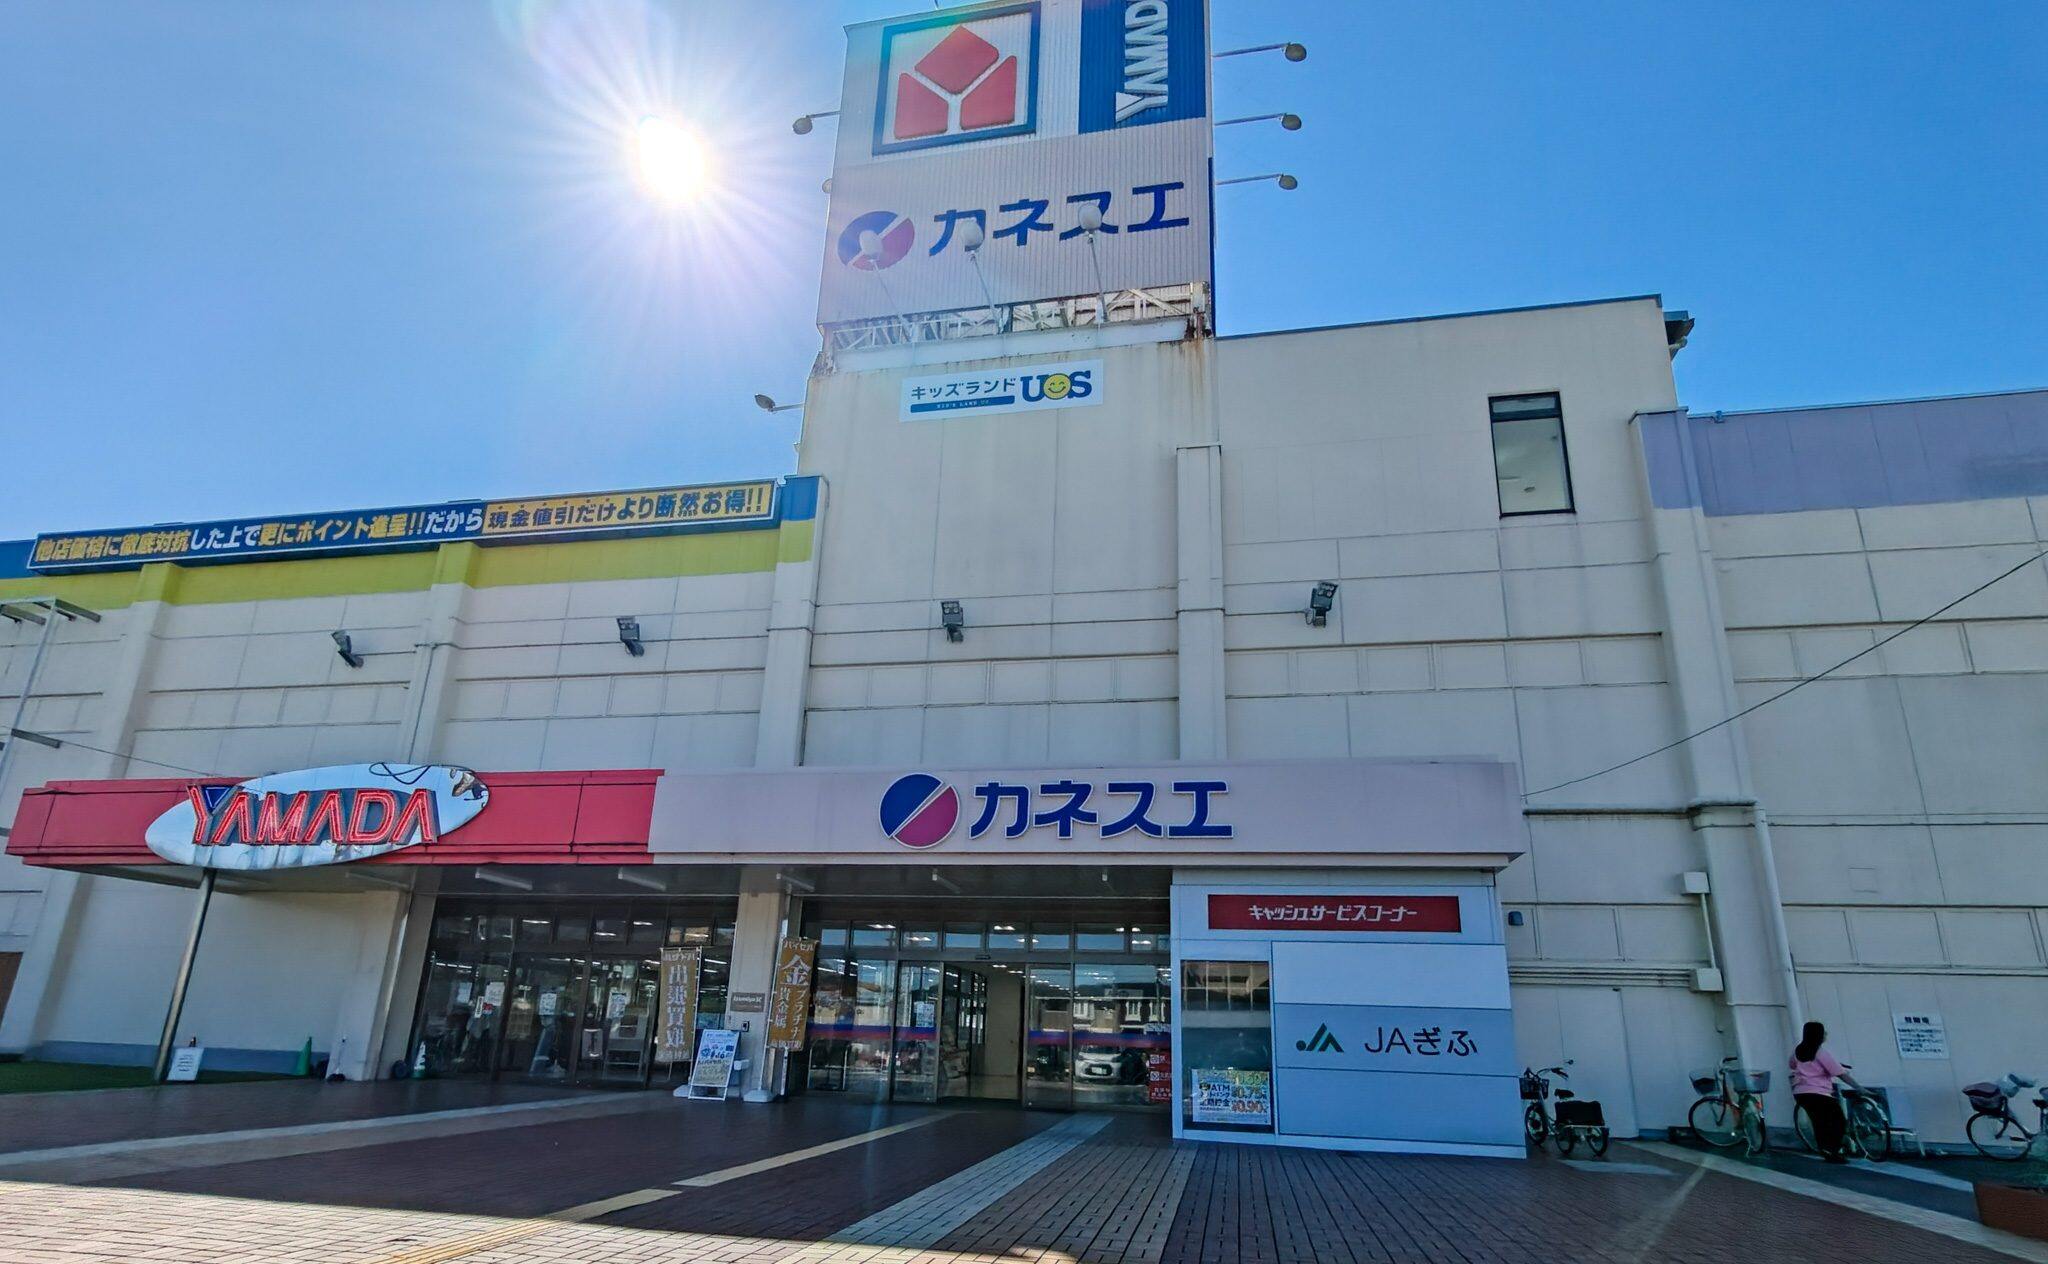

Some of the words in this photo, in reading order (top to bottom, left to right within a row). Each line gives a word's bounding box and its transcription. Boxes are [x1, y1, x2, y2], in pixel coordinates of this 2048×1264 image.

[928, 181, 1190, 257] カネスエ
[911, 377, 1017, 401] キッズランド
[187, 785, 437, 845] YAMADA
[969, 780, 1233, 839] カネスエ
[1249, 904, 1418, 923] キャッシュサービスコーナー
[1364, 1026, 1479, 1057] JAぎふ
